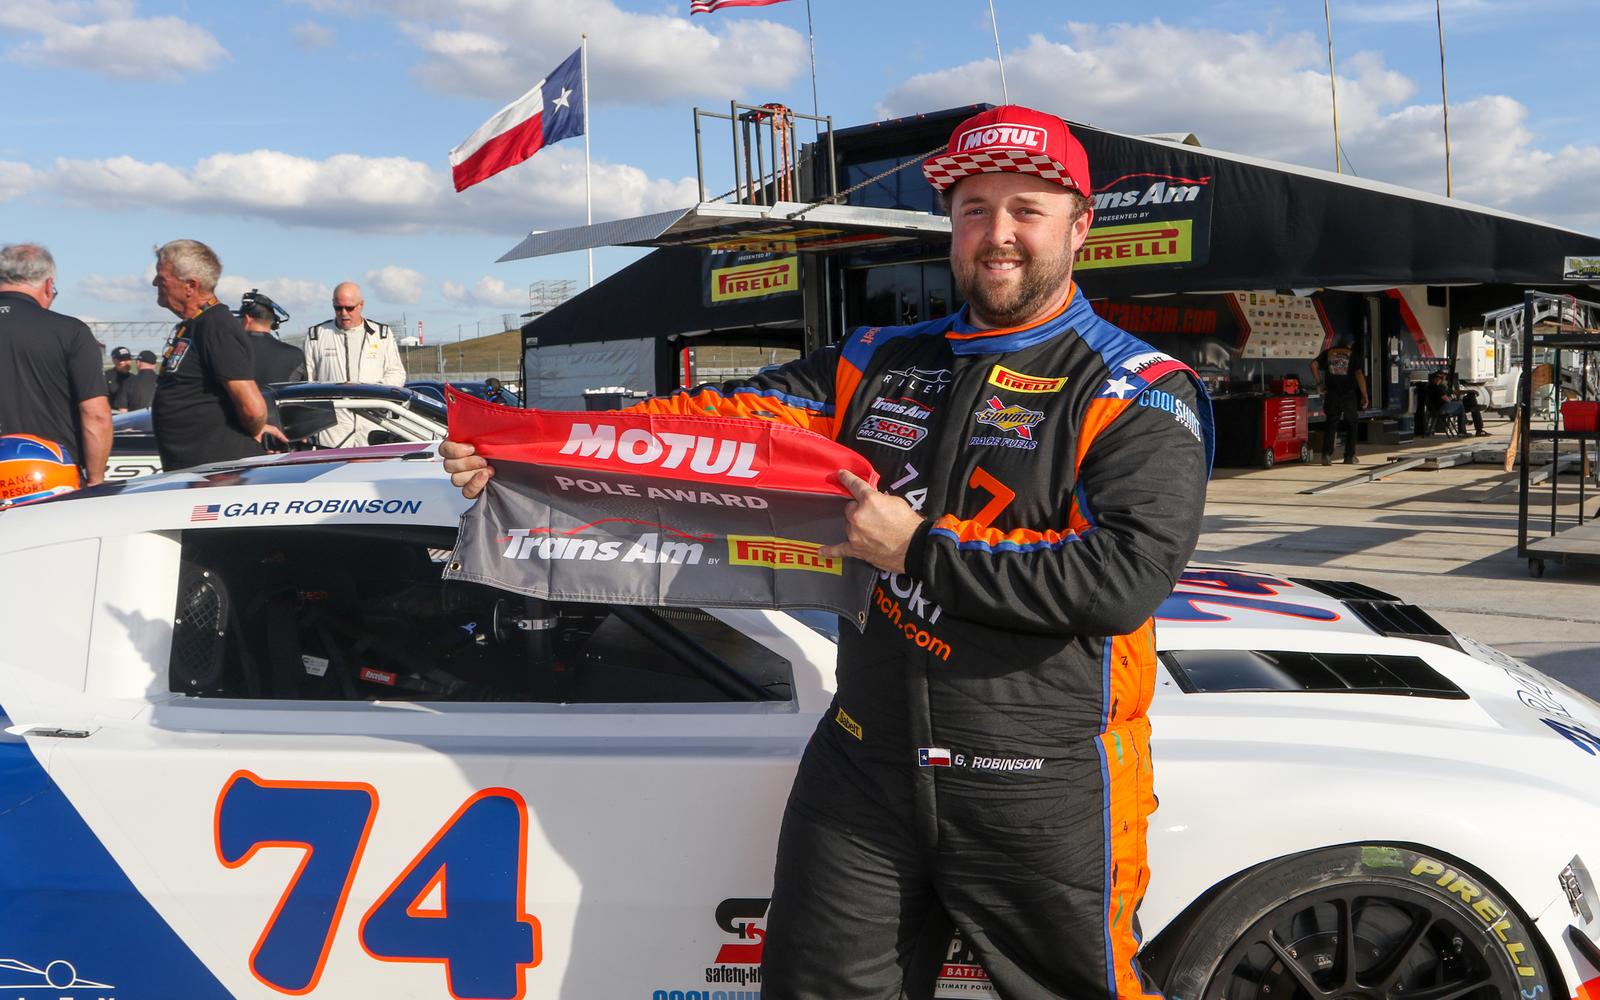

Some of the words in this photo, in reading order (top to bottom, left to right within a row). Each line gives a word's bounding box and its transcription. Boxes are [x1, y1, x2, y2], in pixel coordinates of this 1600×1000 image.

[964, 127, 1038, 150] MOTUL
[1138, 181, 1201, 206] Am
[1098, 212, 1138, 222] PRESENTED
[1139, 211, 1150, 219] BY
[1075, 228, 1179, 263] IRELLI
[718, 263, 791, 295] PIRELLI
[882, 374, 945, 394] RILEY
[995, 369, 1060, 392] PIRELLI
[871, 396, 906, 415] Trans
[903, 405, 932, 420] Am
[980, 410, 1039, 424] SUNOCO
[1138, 389, 1201, 437] COOLSHIRT
[858, 429, 874, 437] PRO
[874, 432, 913, 447] RACING
[876, 420, 919, 440] SCCA
[559, 423, 763, 479] MOTUL
[968, 436, 1001, 446] RACE
[1000, 437, 1038, 450] FUELS
[556, 475, 644, 499] POLE
[647, 486, 770, 510] AWARD
[223, 500, 281, 518] GAR
[285, 499, 423, 516] ROBINSON
[502, 528, 620, 562] Trans
[620, 532, 705, 566] Am
[707, 557, 720, 566] BY
[736, 539, 834, 569] PIRELLI
[954, 753, 968, 768] G.
[972, 756, 1046, 771] ROBINSON
[213, 768, 543, 1000] 74
[1410, 857, 1537, 978] PIRELLI
